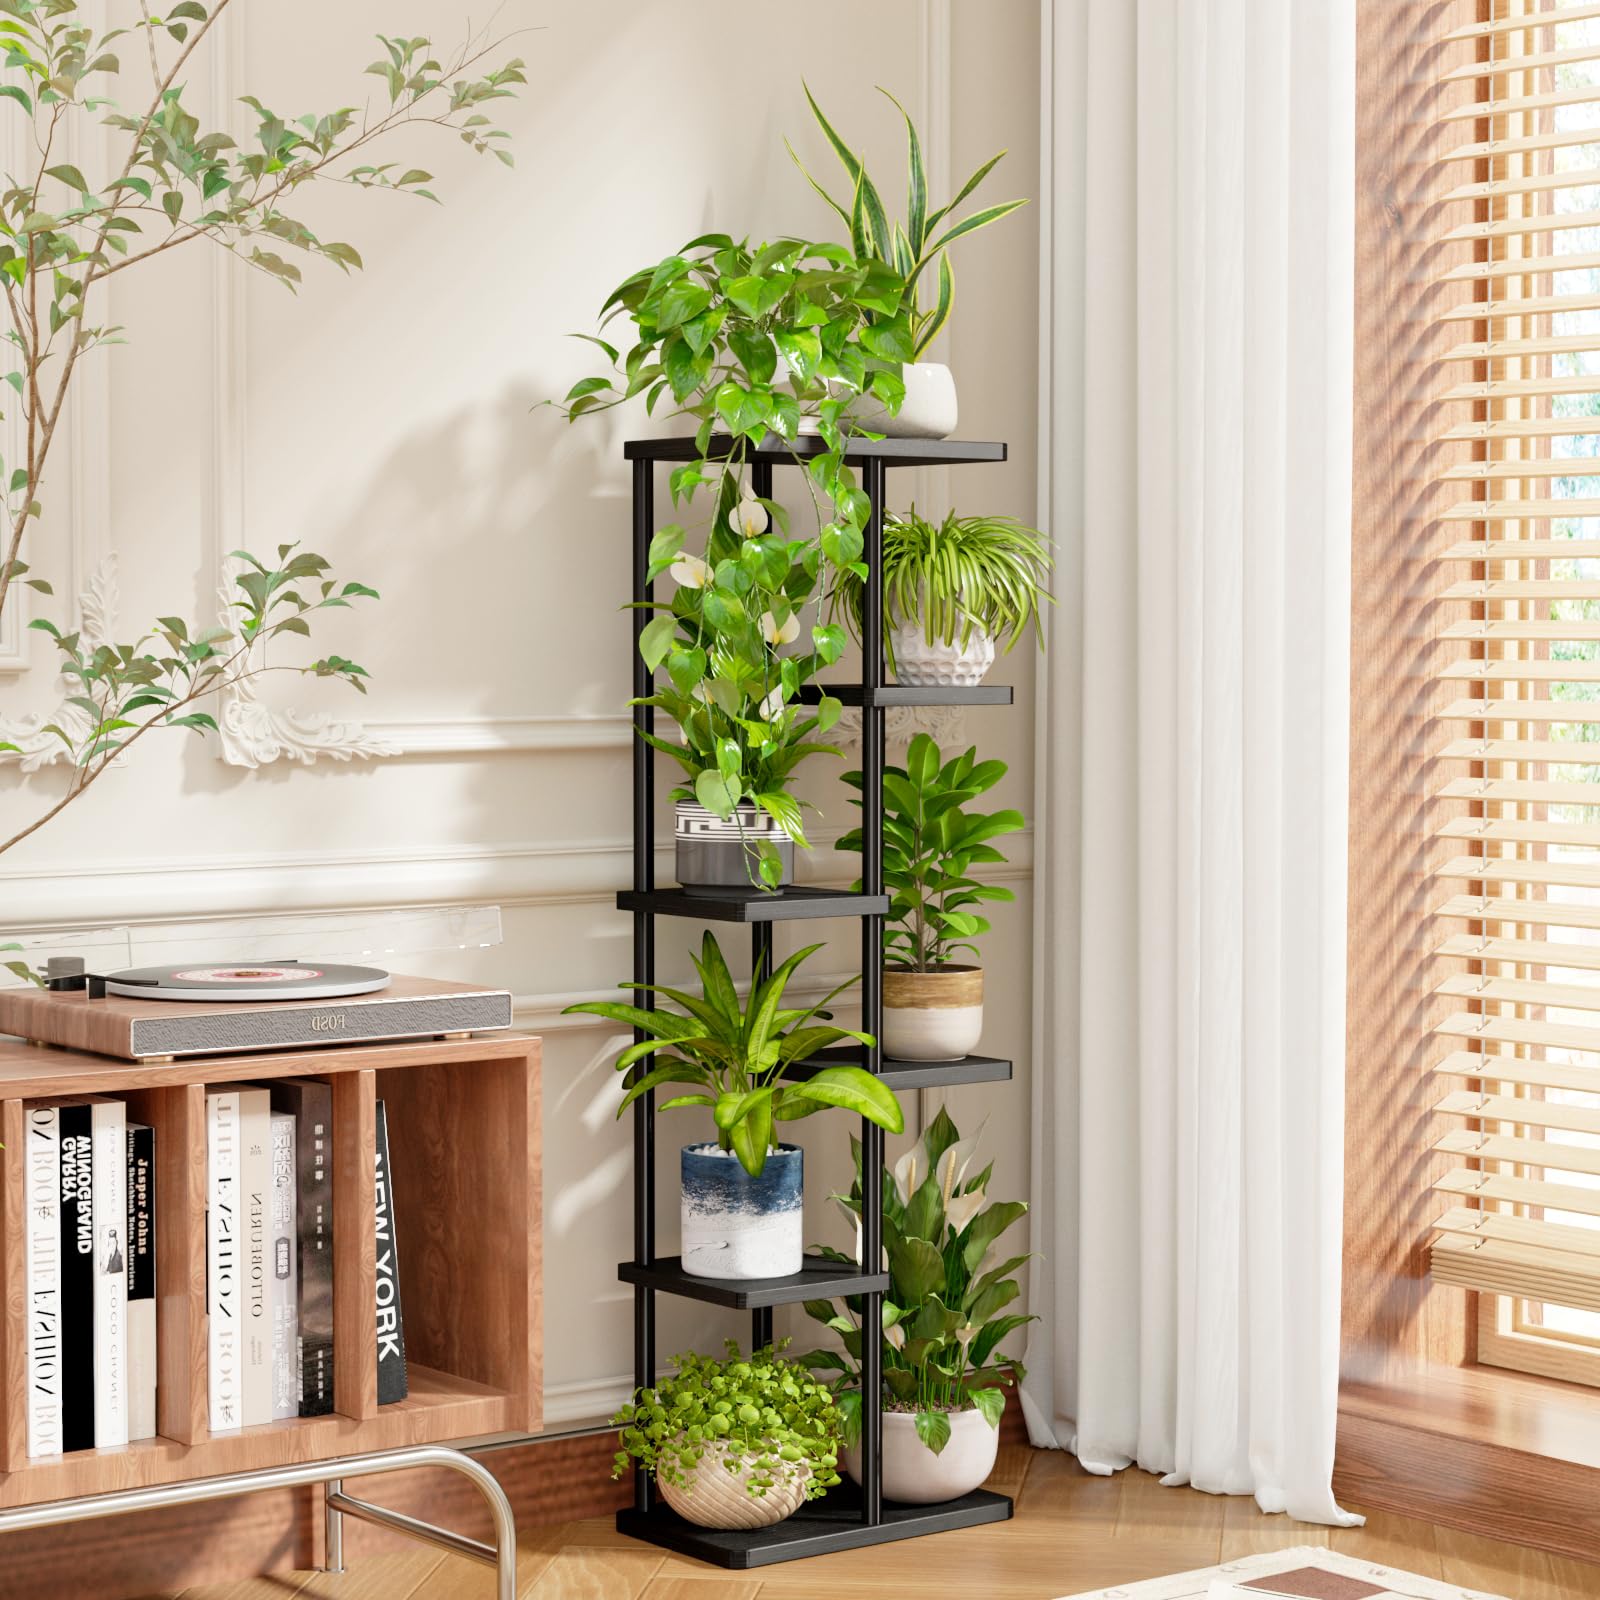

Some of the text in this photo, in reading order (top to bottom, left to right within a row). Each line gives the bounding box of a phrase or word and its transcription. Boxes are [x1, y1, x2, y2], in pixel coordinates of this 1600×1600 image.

[135, 1158, 149, 1255] Jasper Johns
[376, 1249, 400, 1363] YORK
